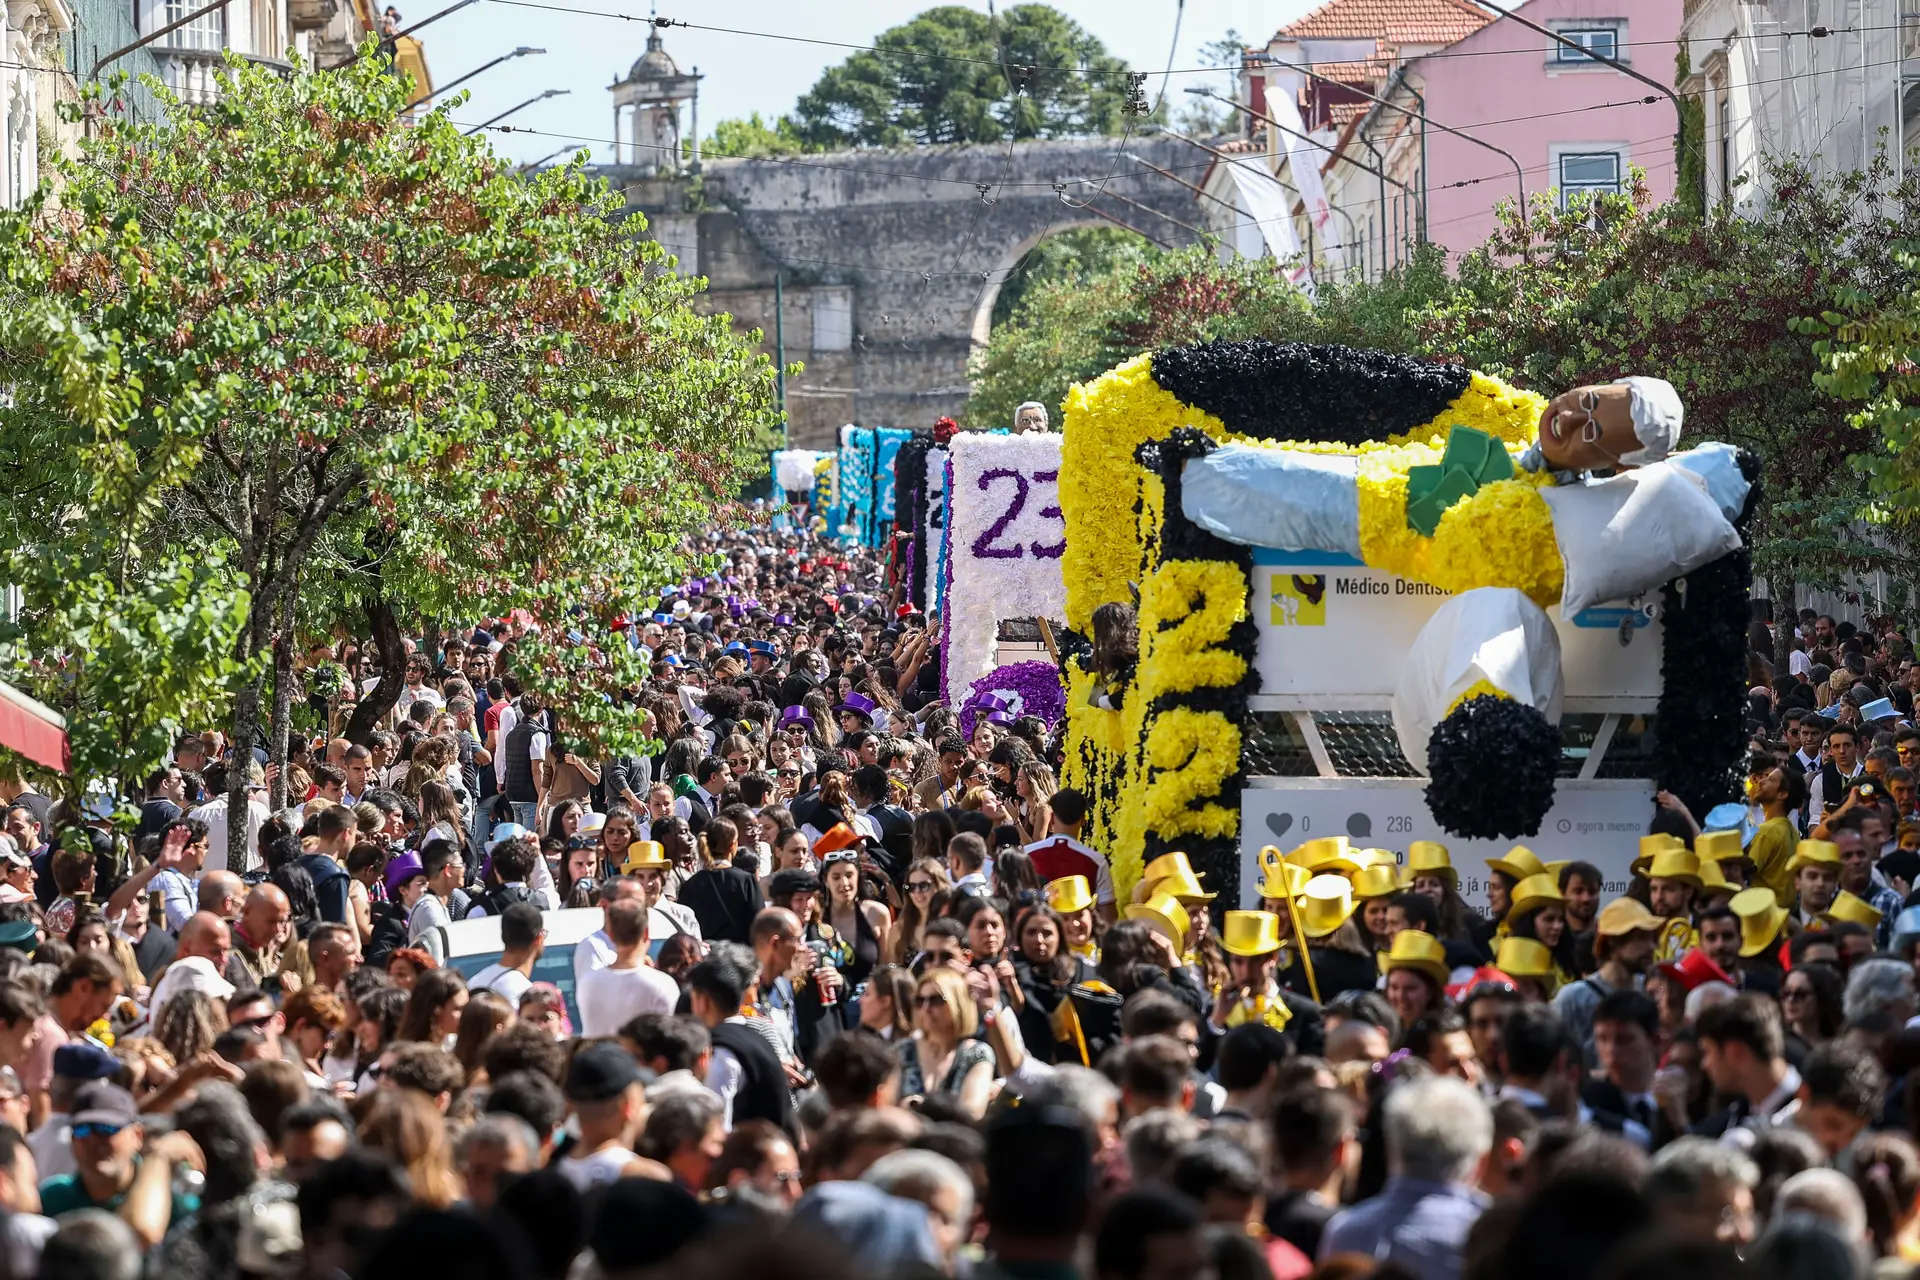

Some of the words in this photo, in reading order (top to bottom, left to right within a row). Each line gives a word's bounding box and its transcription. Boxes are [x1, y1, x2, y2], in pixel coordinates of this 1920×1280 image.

[1336, 577, 1389, 595] Médico
[1395, 578, 1453, 596] Dentis
[1302, 815, 1310, 832] 0
[1387, 816, 1413, 832] 236
[1576, 822, 1604, 835] agora
[1606, 822, 1640, 832] mesmo
[1465, 876, 1479, 896] já
